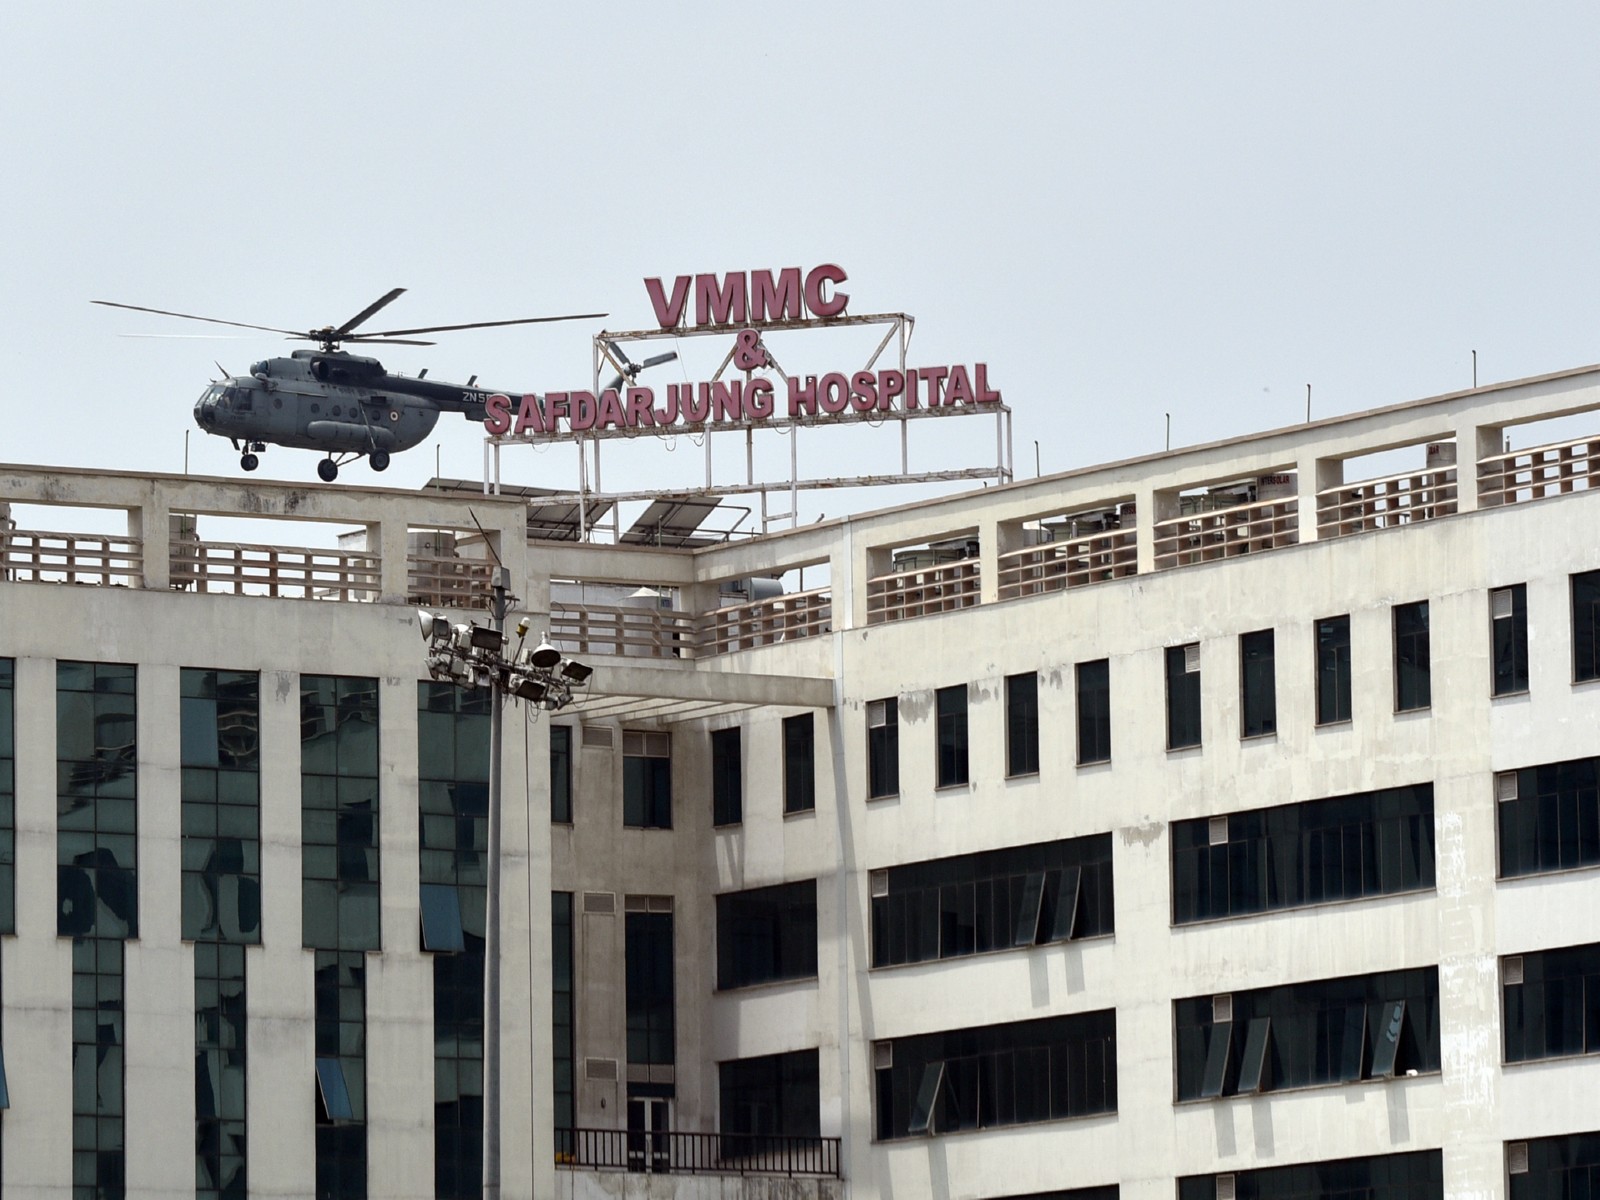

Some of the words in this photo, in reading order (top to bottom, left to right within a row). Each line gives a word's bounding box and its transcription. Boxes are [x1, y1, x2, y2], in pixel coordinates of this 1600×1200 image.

[643, 263, 849, 328] VMMC
[733, 328, 768, 371] &
[483, 378, 775, 435] SAFDARJUNG
[787, 362, 1001, 417] HOSPITAL
